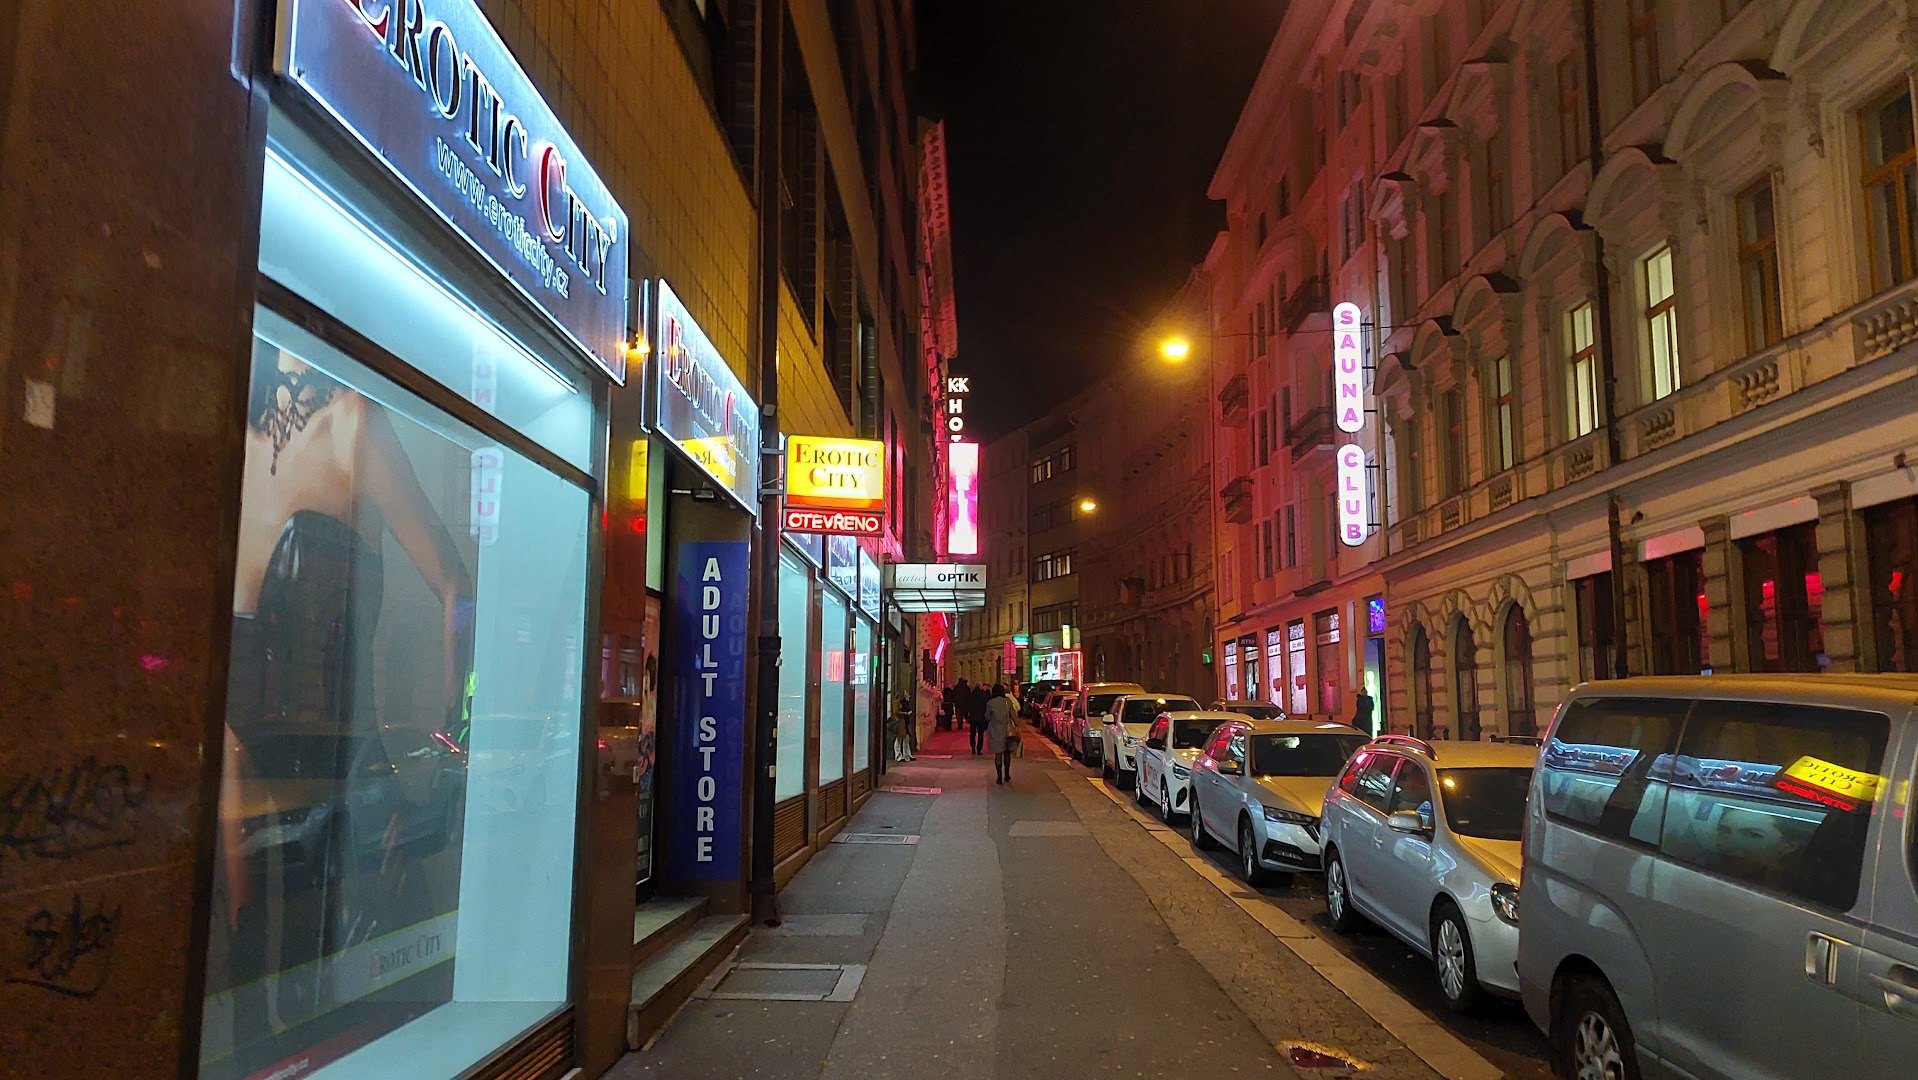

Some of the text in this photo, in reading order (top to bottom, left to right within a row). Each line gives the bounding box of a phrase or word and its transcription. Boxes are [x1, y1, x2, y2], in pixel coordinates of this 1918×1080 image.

[437, 136, 569, 299] www.eroticcity.cz
[538, 141, 613, 296] CITY
[664, 311, 723, 433] EROTIC
[724, 389, 754, 464] CITY
[1340, 310, 1359, 423] SAUNA
[794, 443, 878, 468] EROTIC
[808, 467, 862, 488] CITY
[1343, 452, 1362, 540] CLUB
[788, 512, 879, 532] OTEVŘENO
[937, 572, 979, 582] OPTIK
[696, 557, 722, 862] ADULT STORE
